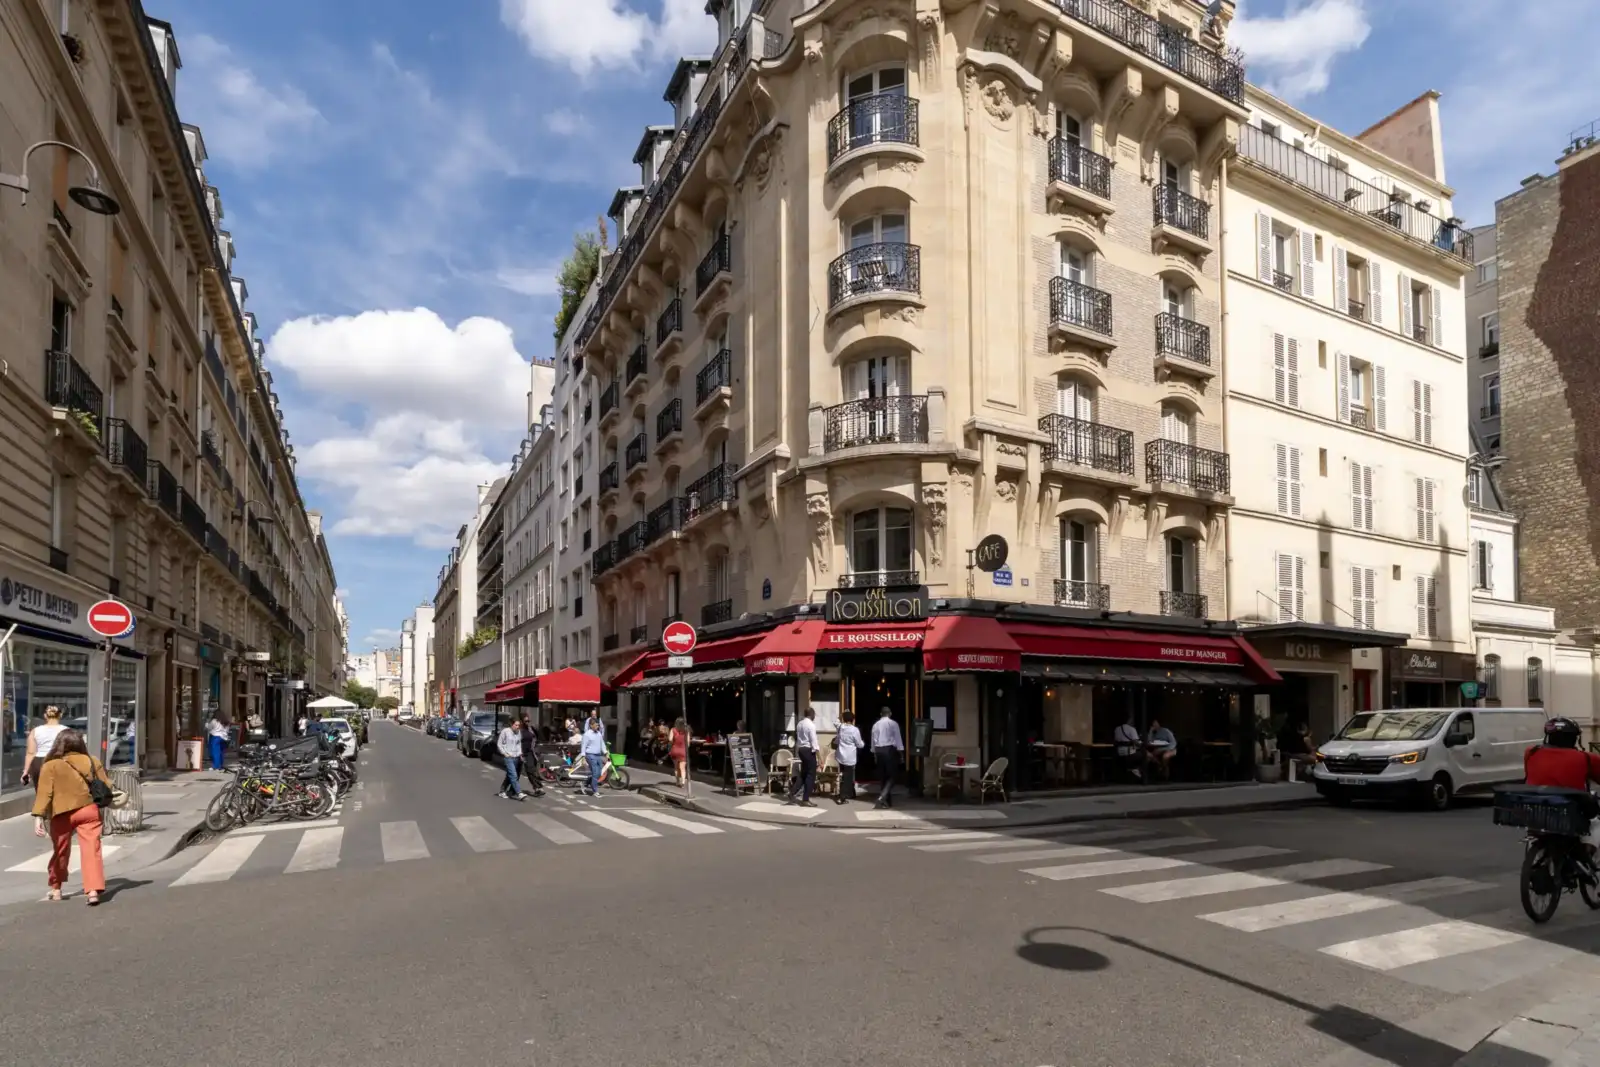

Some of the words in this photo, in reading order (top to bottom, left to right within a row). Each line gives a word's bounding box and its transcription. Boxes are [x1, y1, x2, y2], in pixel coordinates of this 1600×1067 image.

[14, 581, 43, 608] PETIT
[830, 634, 845, 643] LE
[848, 632, 925, 643] ROUSSILLON
[1161, 648, 1184, 656] BOIRE
[1185, 649, 1195, 657] ET
[1196, 650, 1227, 660] MANGER
[1285, 641, 1322, 659] NOIR
